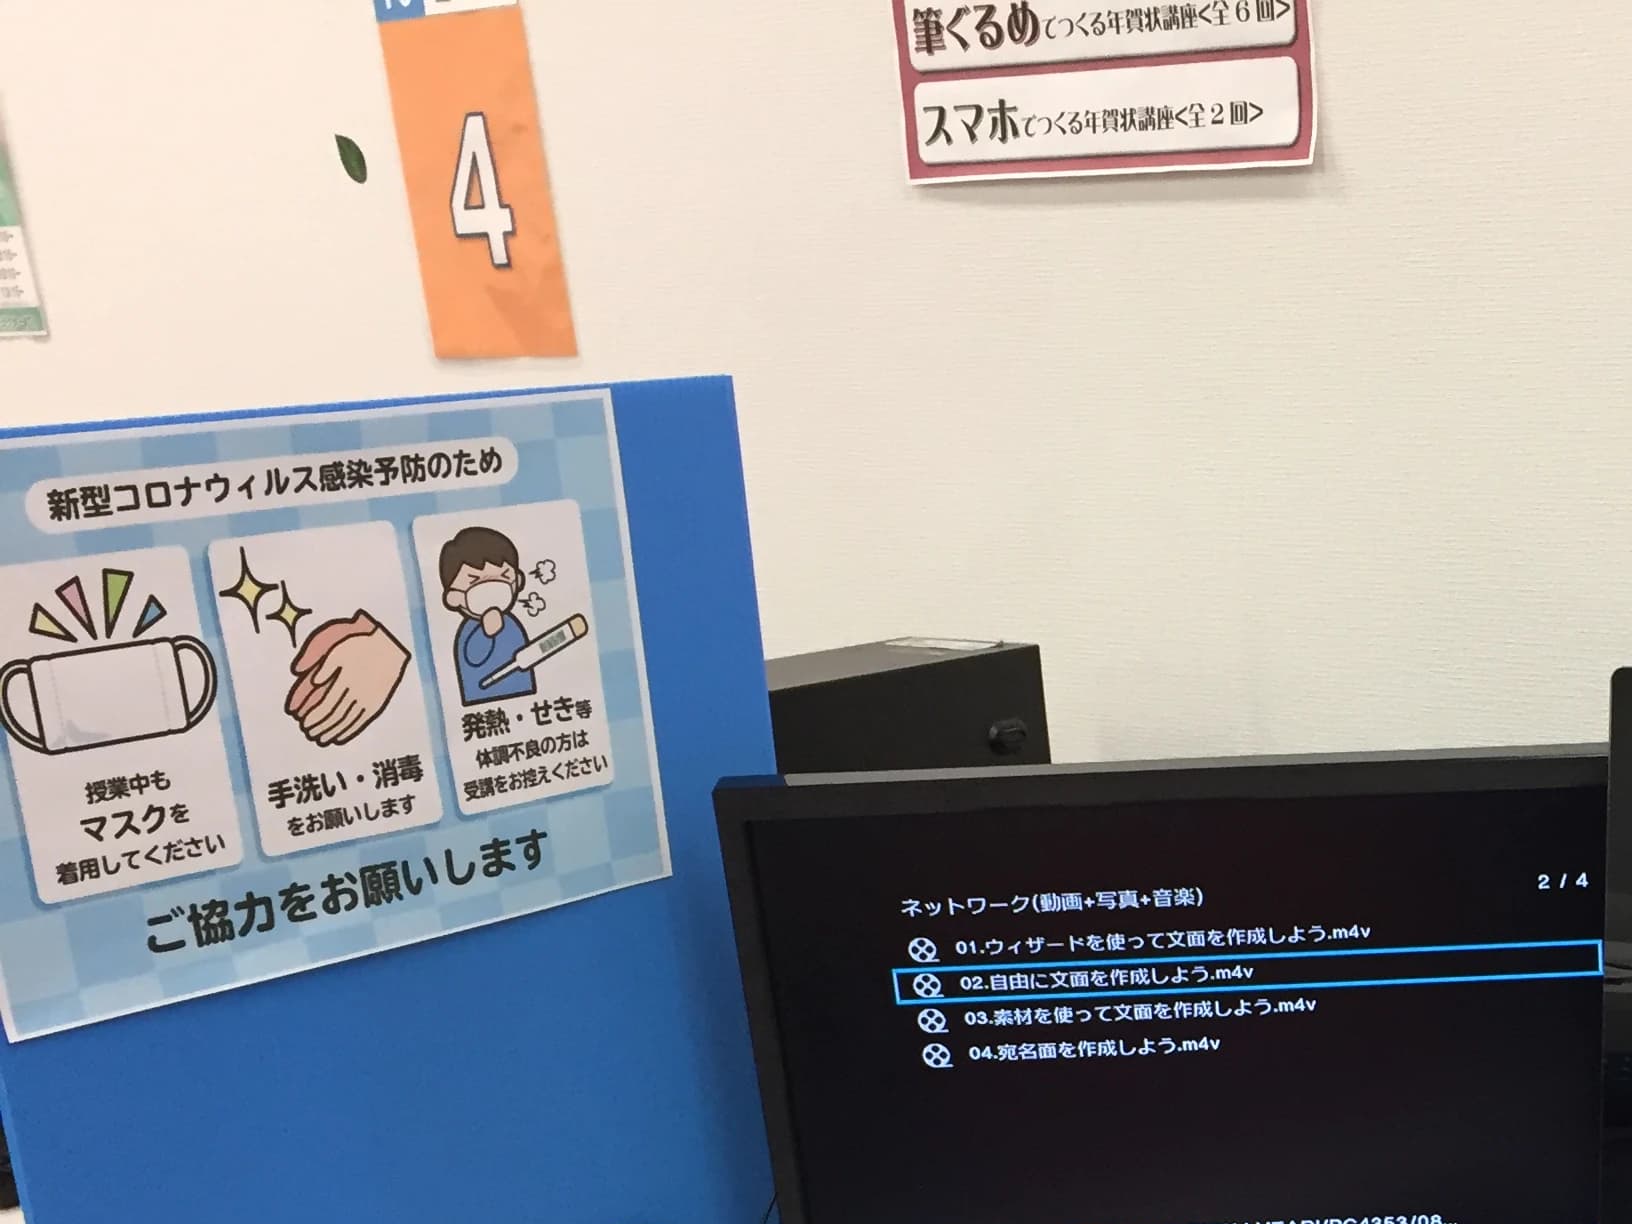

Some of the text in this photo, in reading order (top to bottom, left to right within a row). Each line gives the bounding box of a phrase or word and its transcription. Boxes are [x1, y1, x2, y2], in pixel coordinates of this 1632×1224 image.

[450, 111, 516, 269] 4
[46, 446, 503, 522] 新型コロナウィルス感染予防のため
[462, 696, 593, 742] 発熱・せき等
[476, 730, 590, 769] 体調不良の方は
[85, 769, 172, 800] 授業中も
[267, 753, 425, 808] 手洗い・消毒
[463, 755, 609, 802] 受講をお控えください
[80, 802, 191, 842] マスクを
[287, 794, 417, 837] をお願いします
[56, 834, 226, 885] 着用してください
[146, 828, 549, 953] ご協力をお願いします
[960, 964, 1255, 991] 02.自由に文面を作成しよう.m4v
